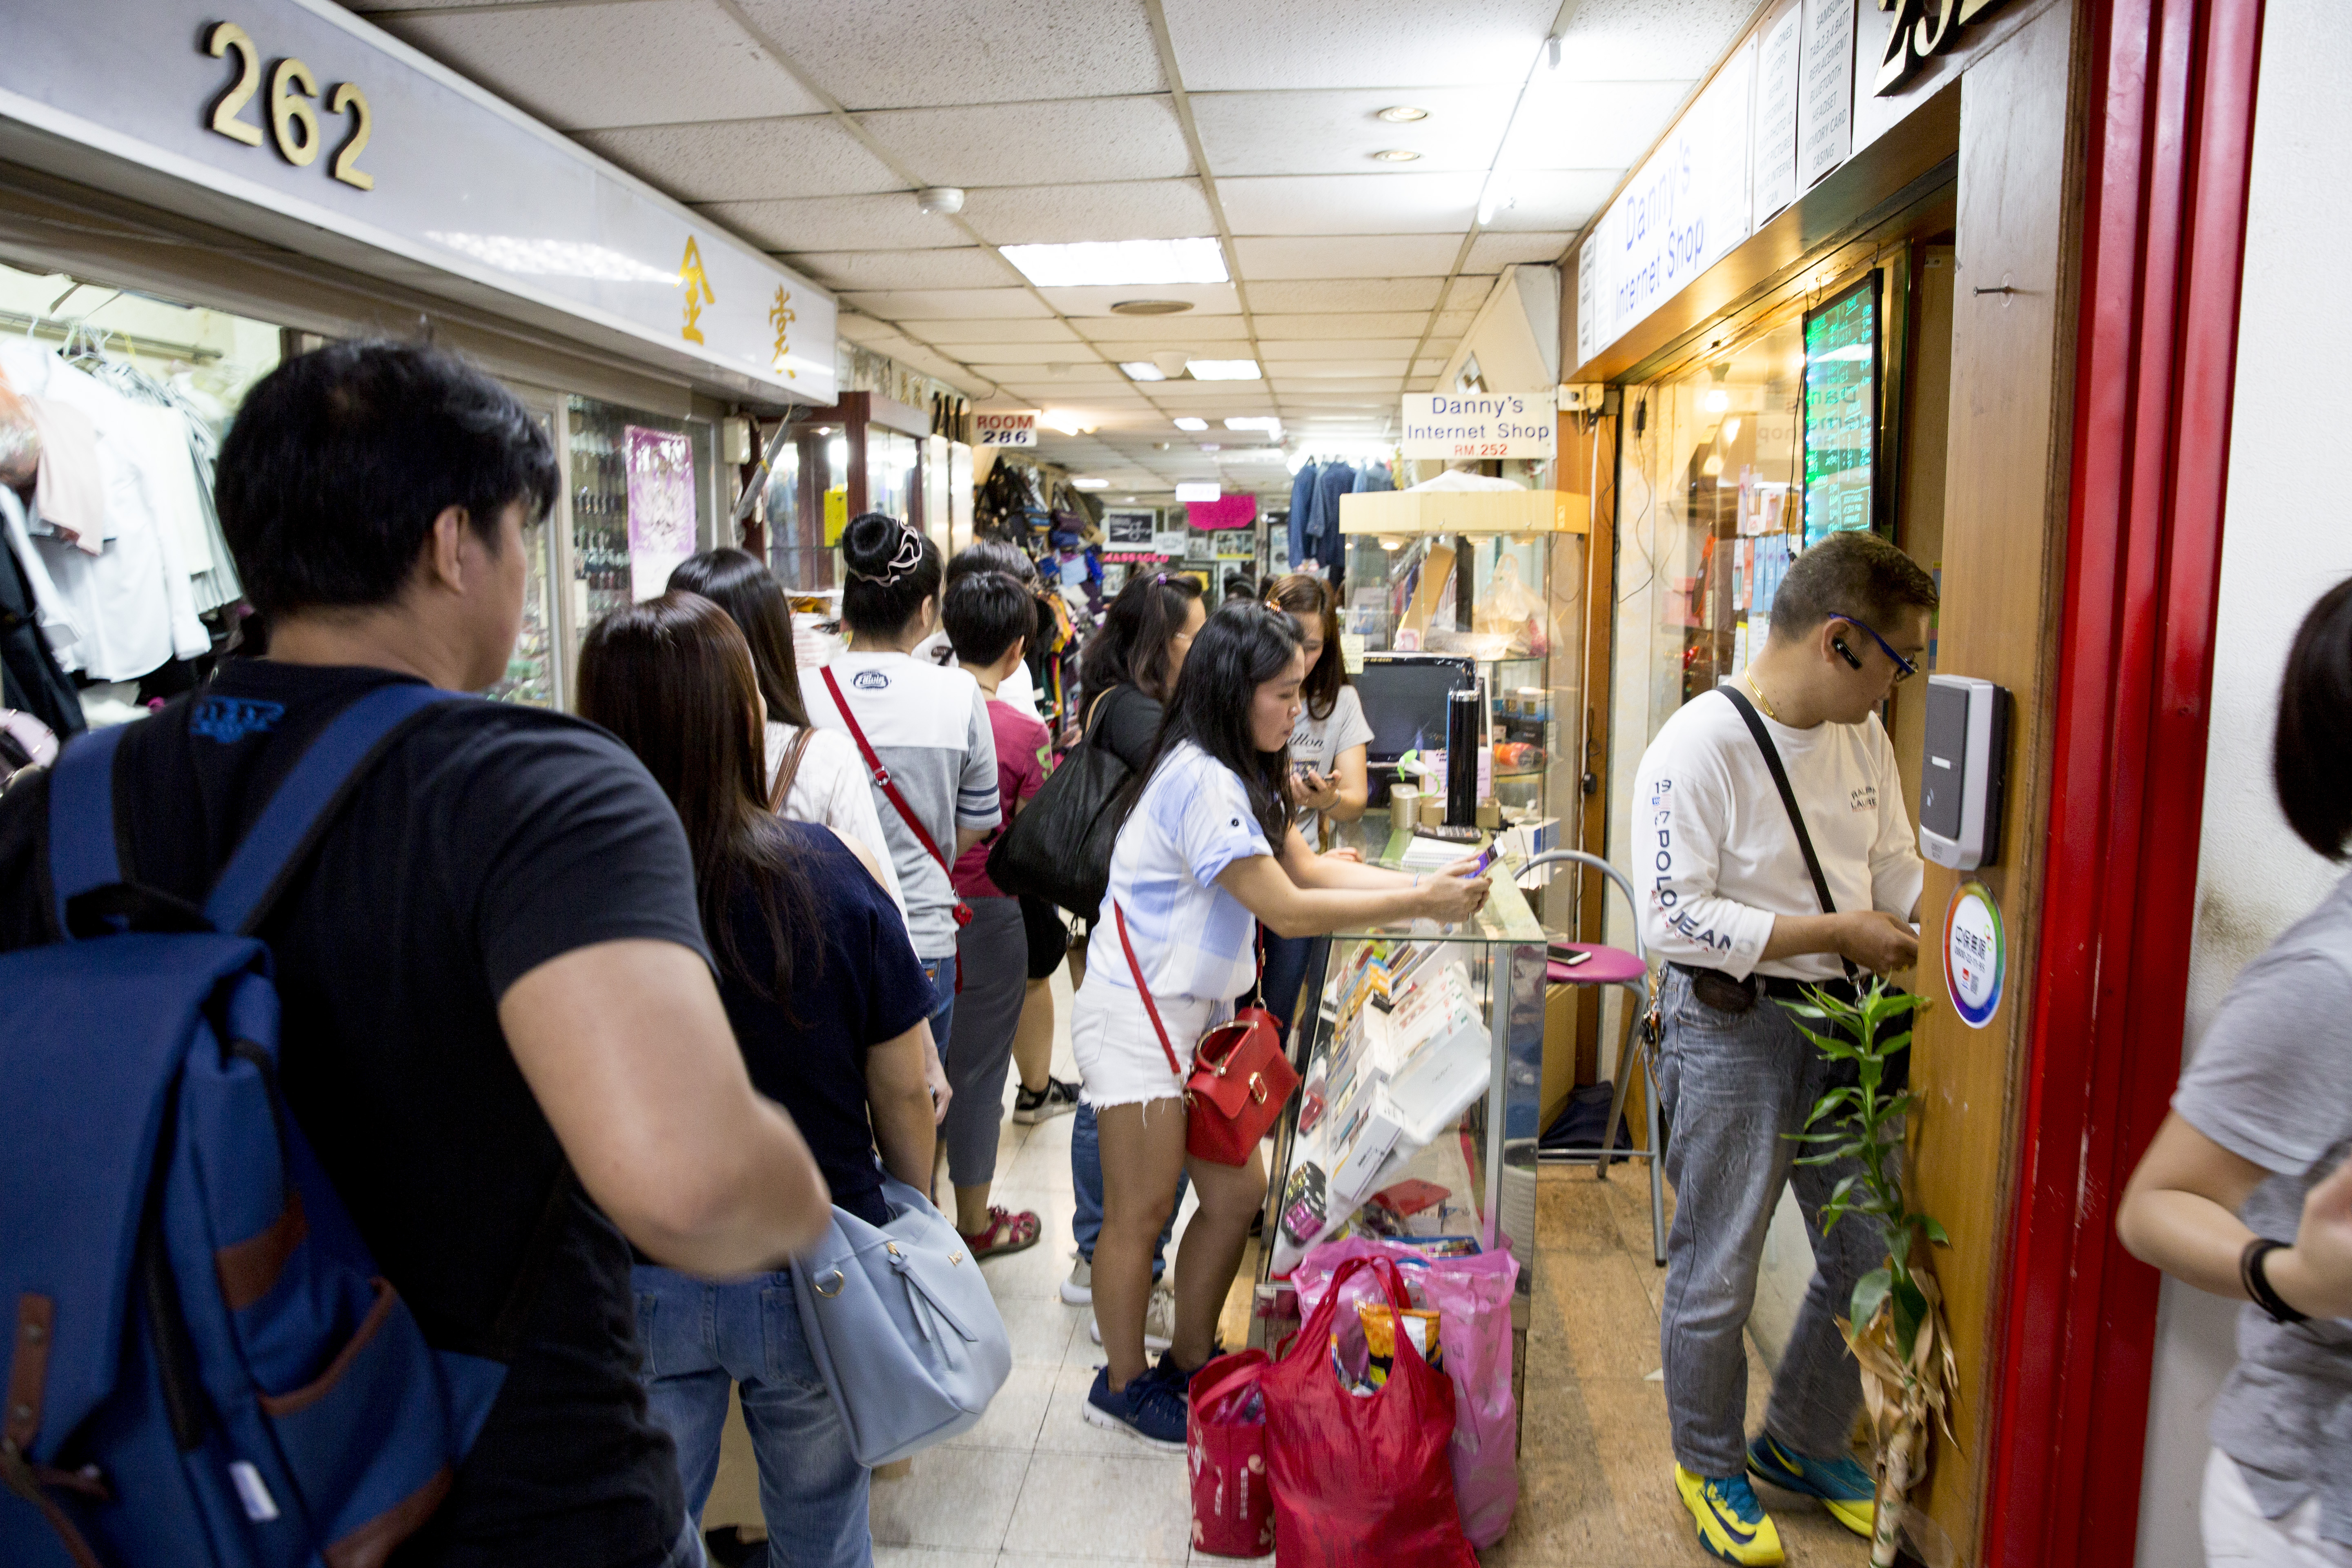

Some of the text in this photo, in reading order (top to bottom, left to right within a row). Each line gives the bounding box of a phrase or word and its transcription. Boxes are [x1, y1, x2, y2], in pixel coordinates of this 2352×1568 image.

[1808, 32, 1848, 84] REPLACEMENT
[1809, 61, 1842, 105] BLUETOOTH
[205, 21, 374, 191] 262
[1812, 91, 1837, 125] HEADSET
[1805, 108, 1846, 156] MEMORY CARD
[1769, 133, 1793, 163] PICTURES
[1813, 142, 1835, 171] CASING
[1626, 137, 1691, 252] Danny's
[1766, 188, 1779, 209] SCAN
[1615, 248, 1661, 323] Internet
[1667, 216, 1704, 278] Shop
[976, 415, 1034, 429] ROOM
[1432, 396, 1523, 418] Danny's
[982, 430, 1027, 444] 286
[1409, 422, 1550, 442] Internet Shop
[1454, 443, 1508, 457] RM.252
